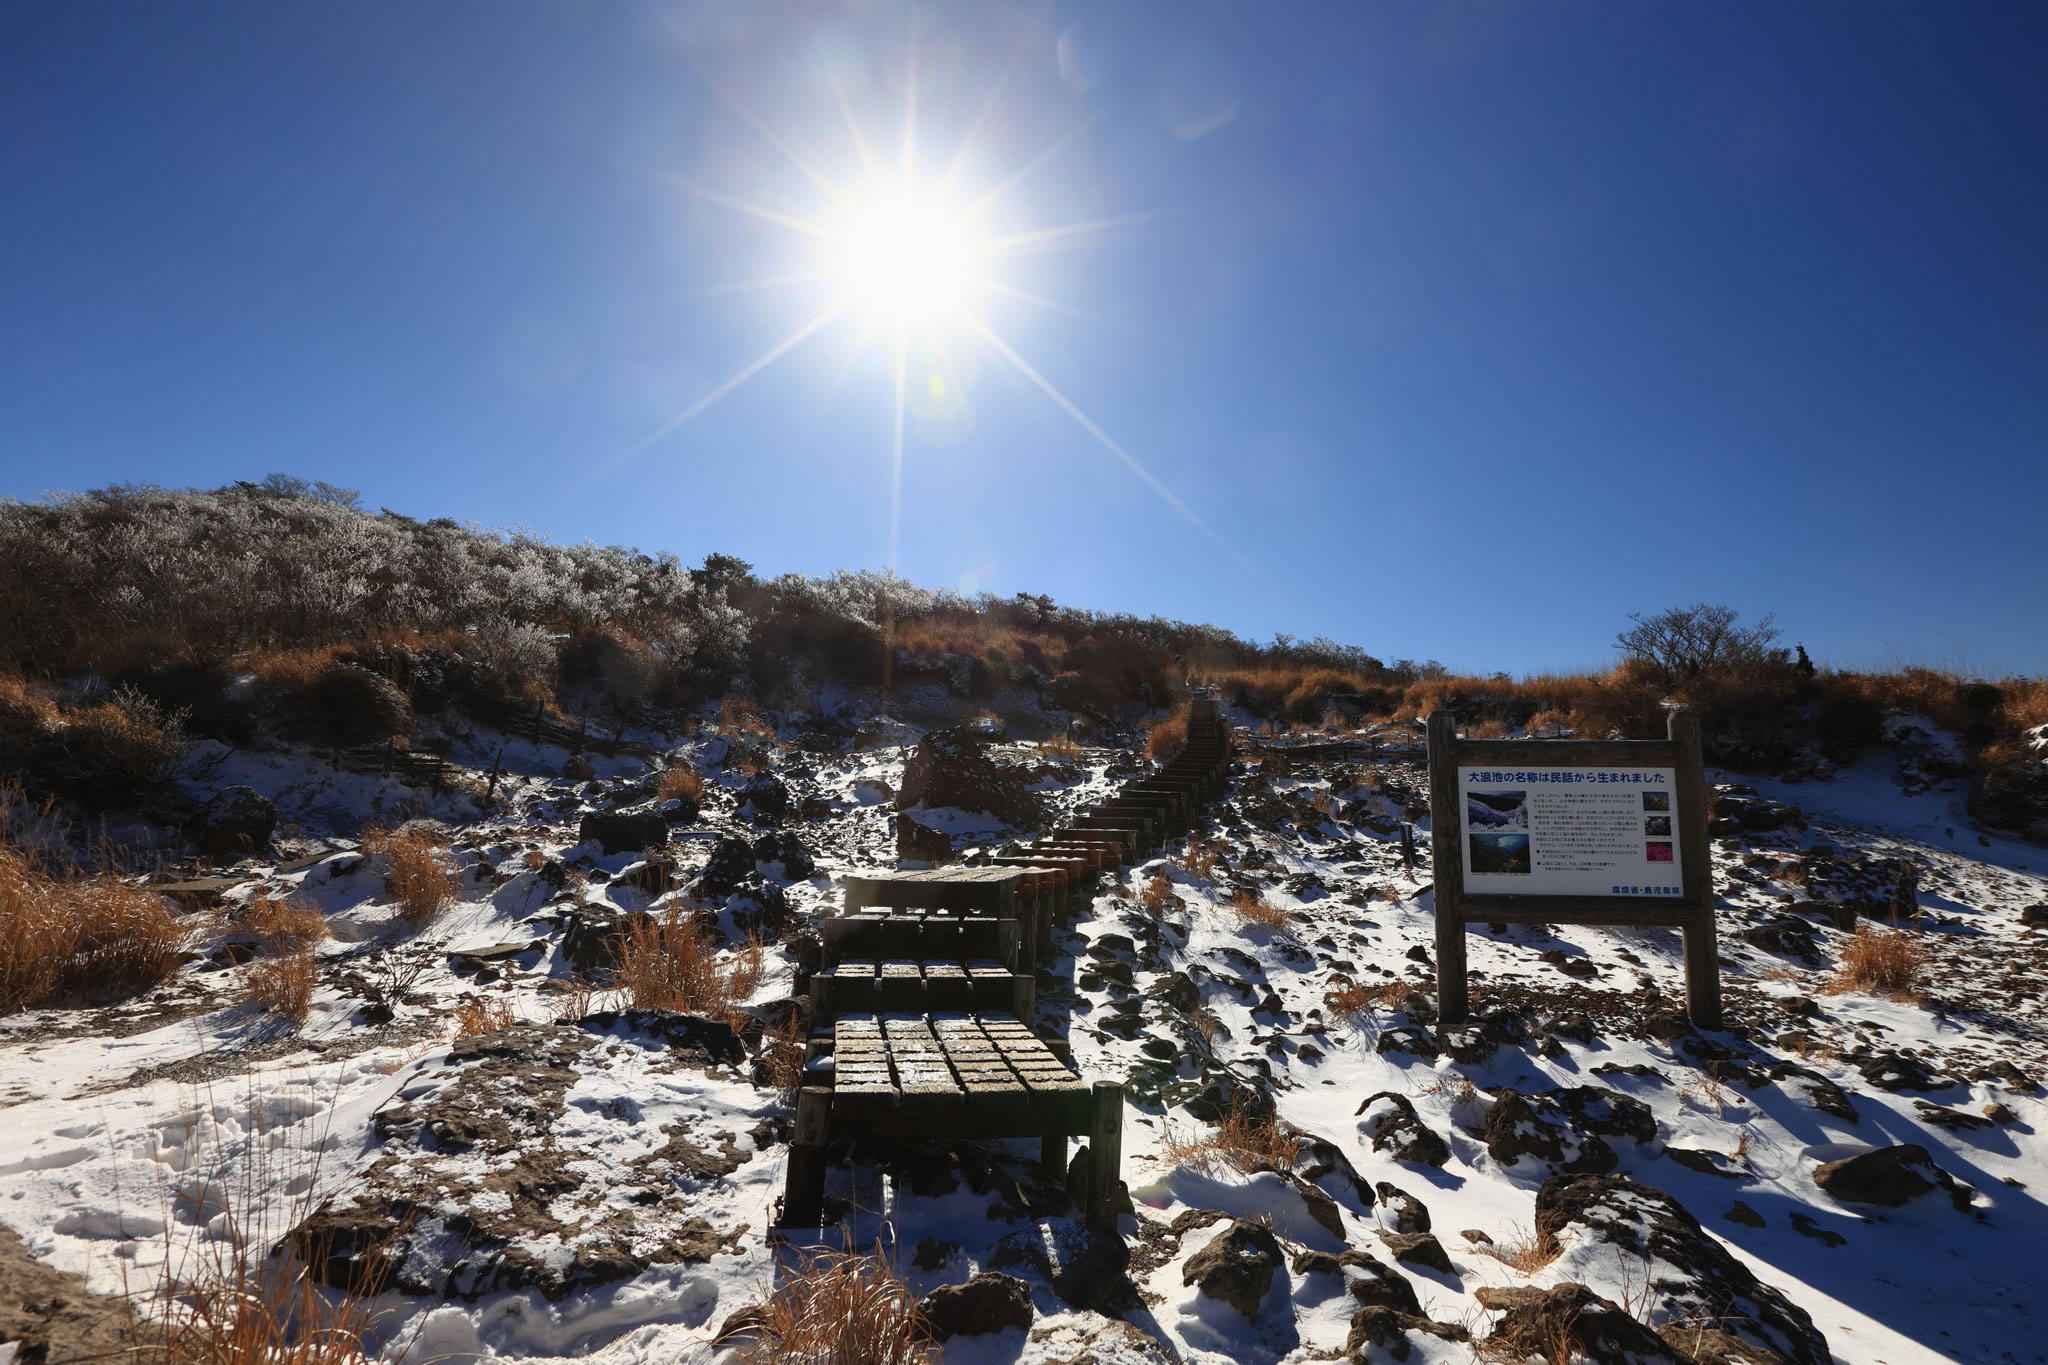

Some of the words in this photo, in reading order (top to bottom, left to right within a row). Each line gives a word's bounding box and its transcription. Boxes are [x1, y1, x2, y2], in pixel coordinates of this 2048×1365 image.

[1468, 771, 1666, 784] 大浪池の名称は民話から生まれました
[1612, 885, 1681, 895] 環境省・鹿児島県
